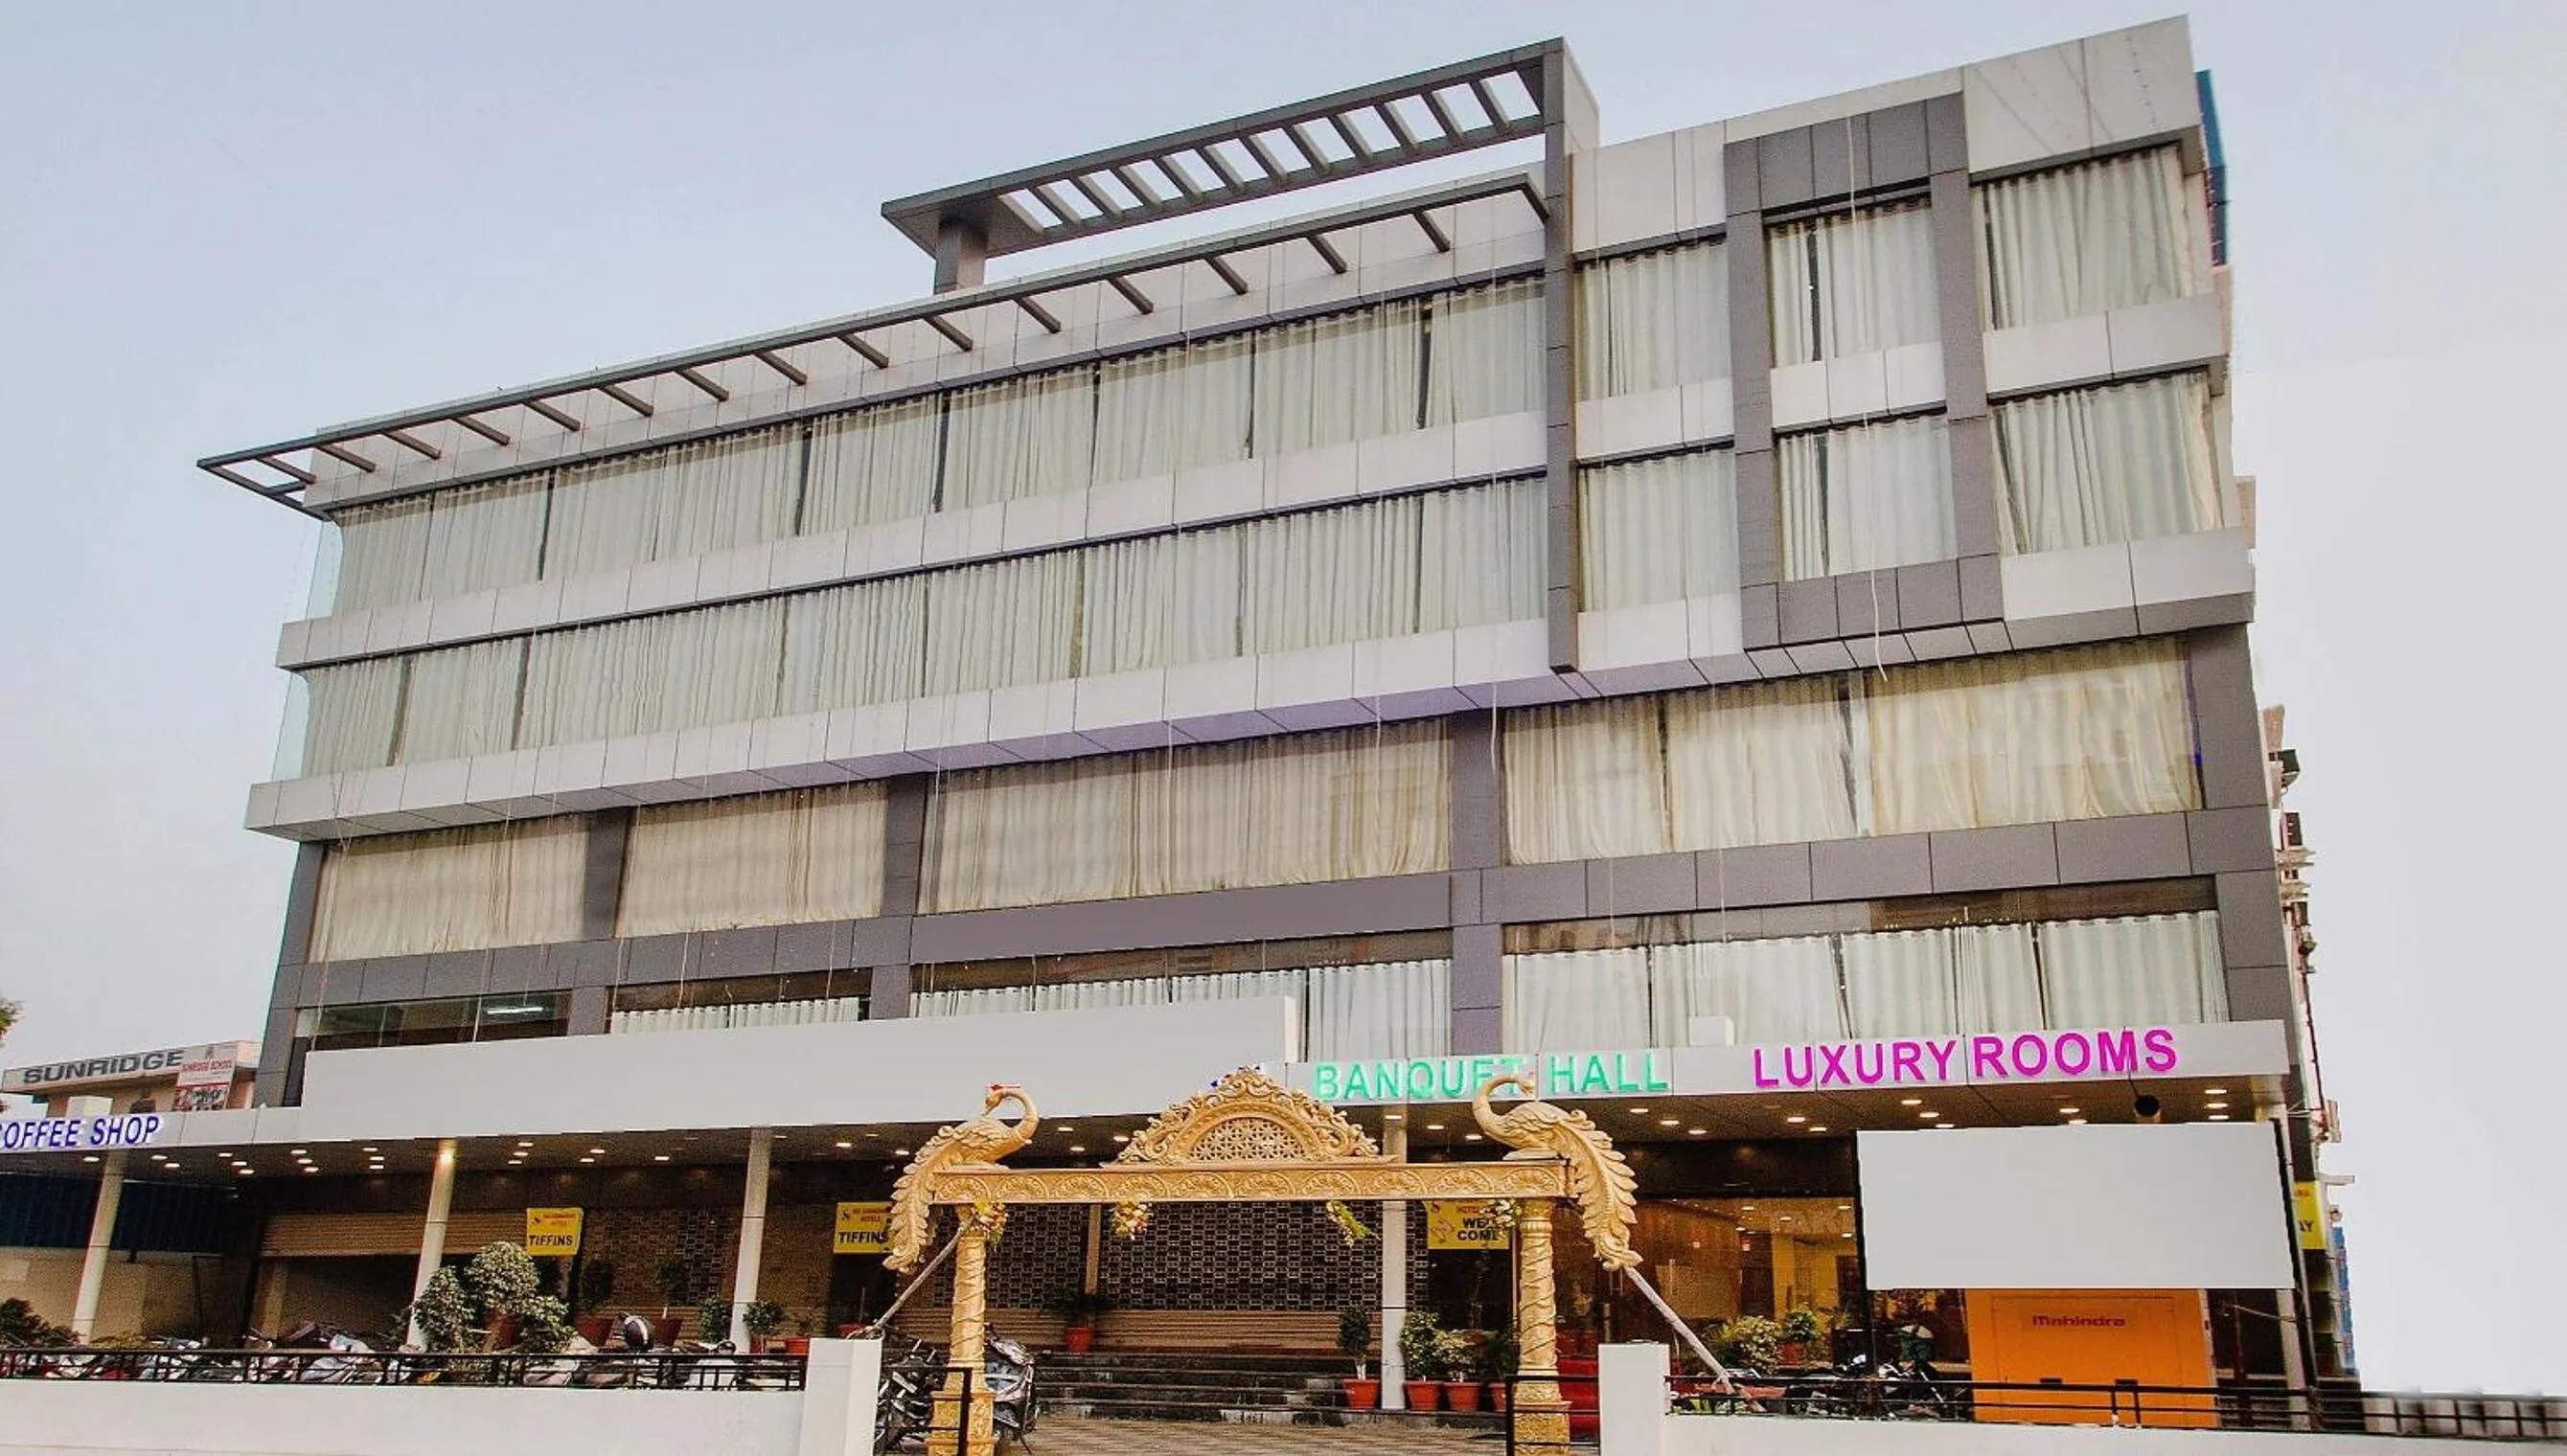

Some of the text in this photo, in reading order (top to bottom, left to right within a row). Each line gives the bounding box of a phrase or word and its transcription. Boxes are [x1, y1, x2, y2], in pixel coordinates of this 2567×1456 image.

[23, 1050, 185, 1083] SUNRIDGE
[1753, 1029, 2177, 1086] LUXURY ROOMS
[1315, 1053, 1670, 1101] BANQUET HALL
[0, 1116, 160, 1149] OFFEE SHOP
[529, 1235, 573, 1246] TIFFINS
[838, 1232, 888, 1244] TIFFINS
